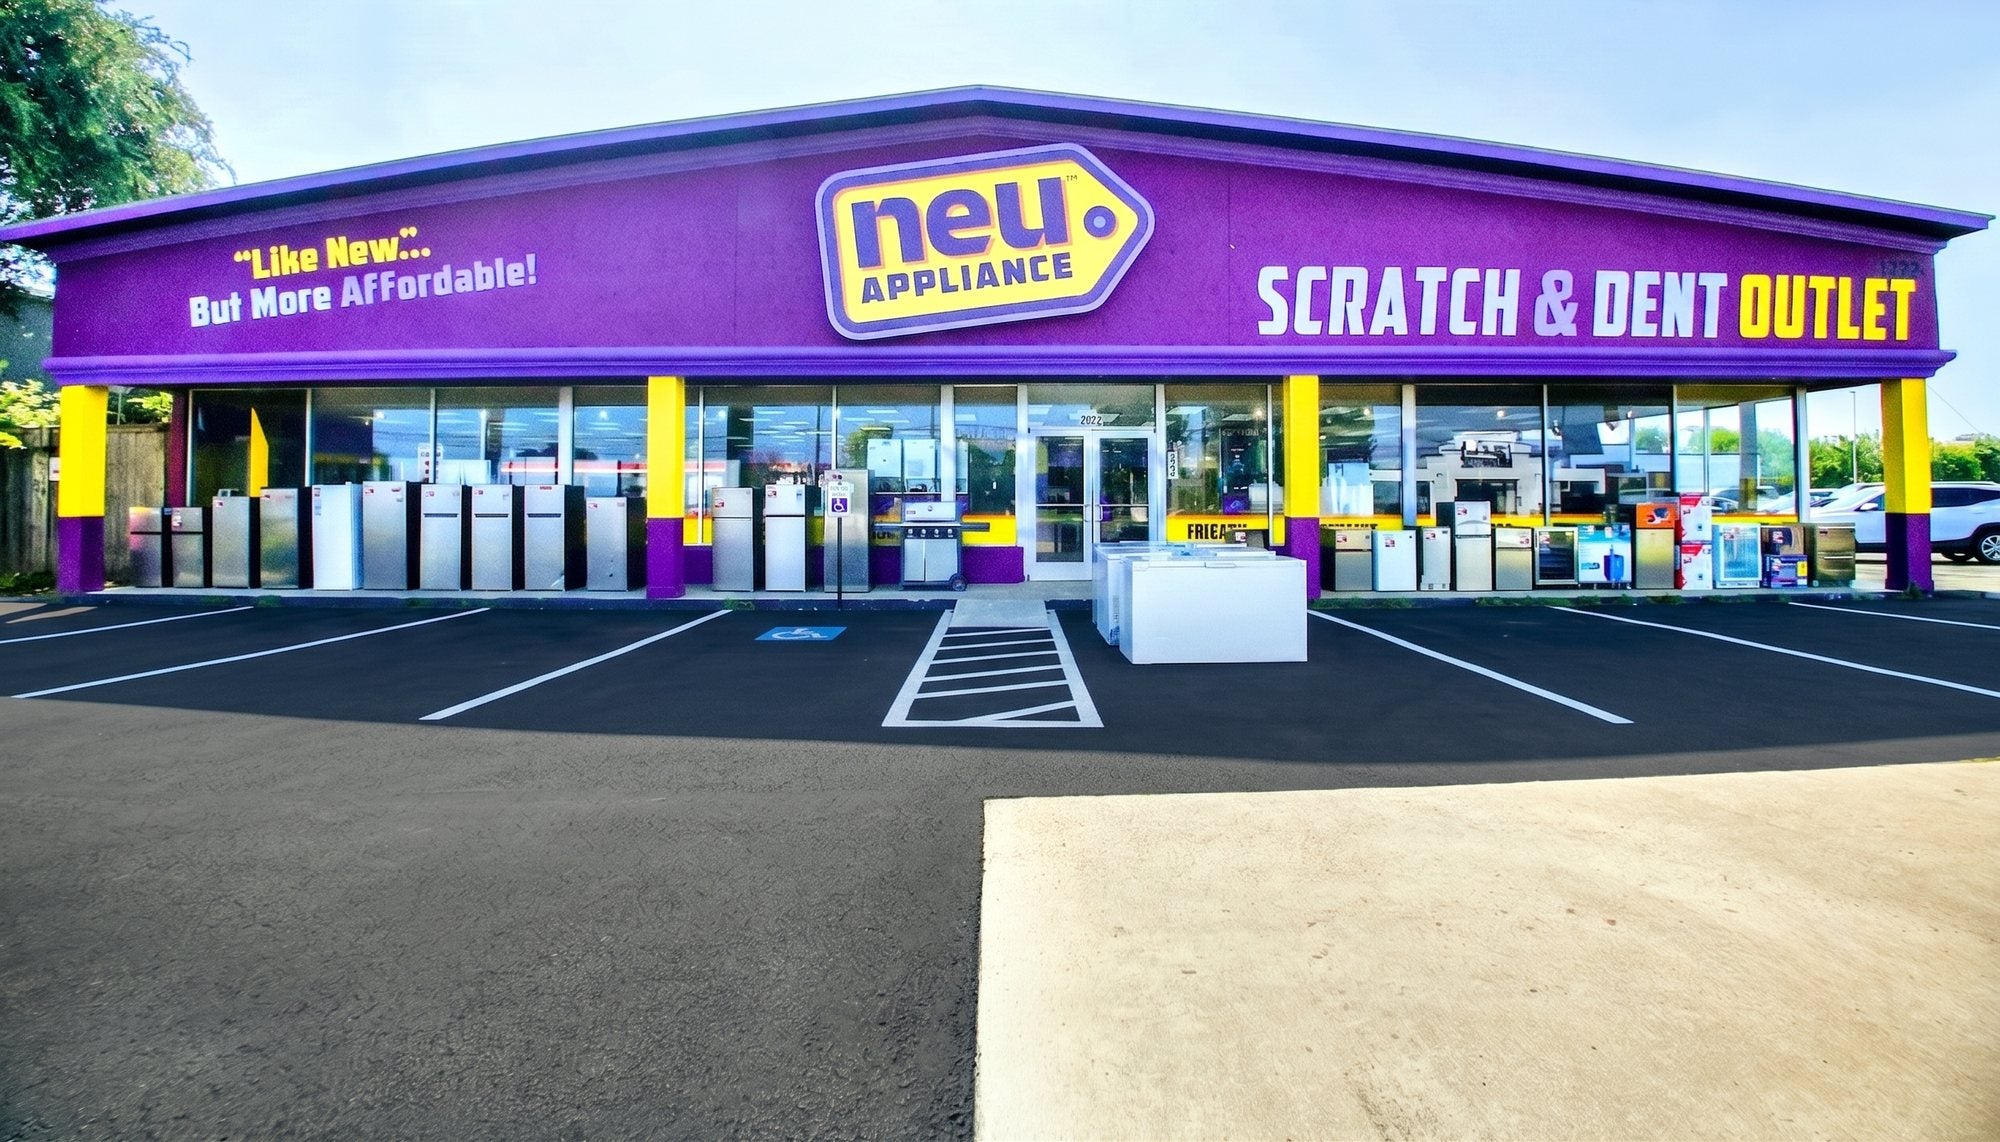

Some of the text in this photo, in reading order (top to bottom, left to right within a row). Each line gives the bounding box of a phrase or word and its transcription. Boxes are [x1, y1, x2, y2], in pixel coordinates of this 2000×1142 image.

[851, 176, 1072, 268] neu
[861, 252, 1073, 304] APPLIANCE
[1257, 265, 1917, 341] SCRATCH & DENT OUTLET
[189, 292, 243, 328] But
[249, 284, 333, 320] More
[1080, 415, 1103, 426] 2022
